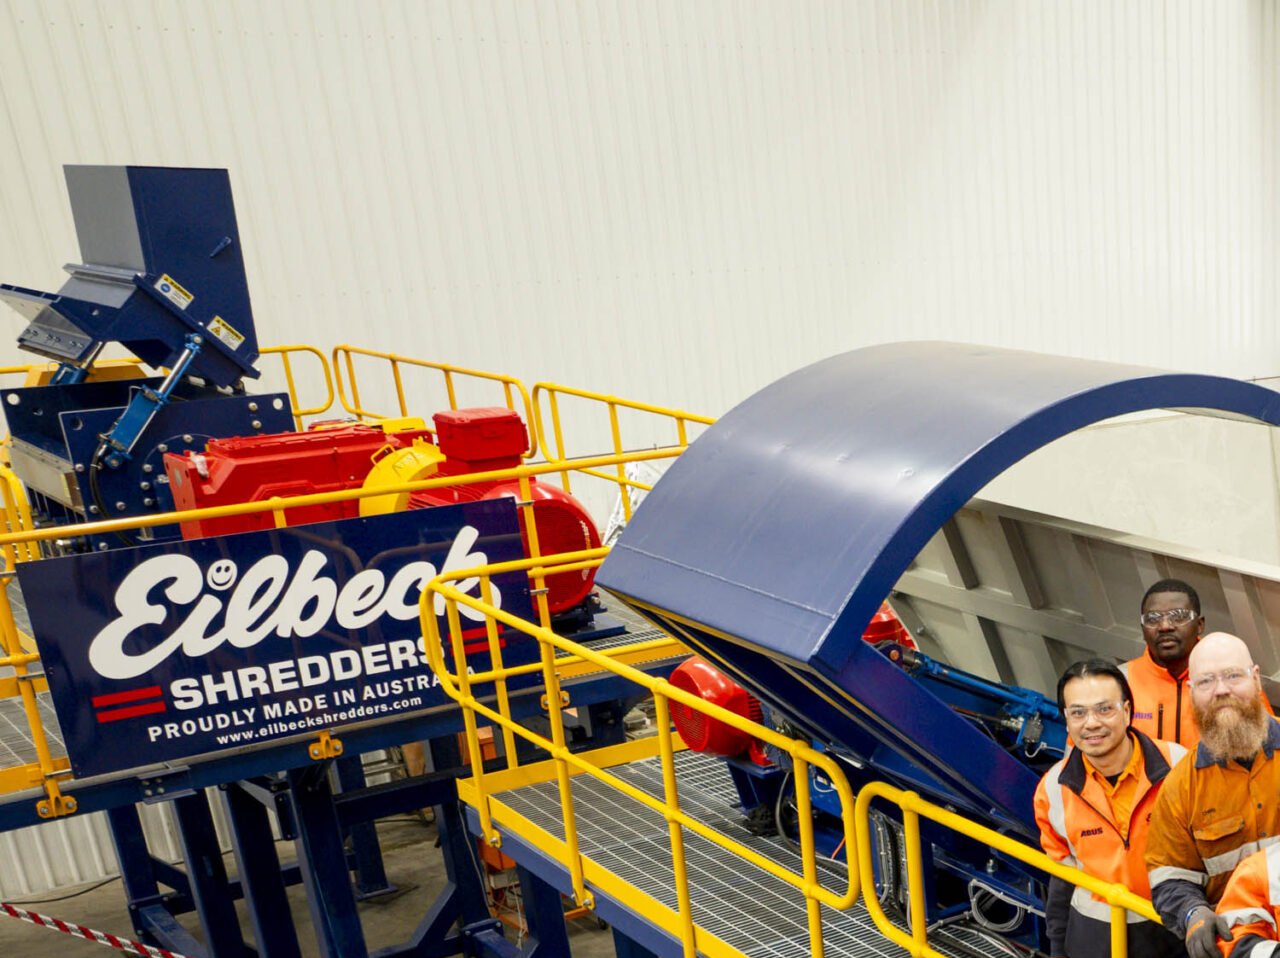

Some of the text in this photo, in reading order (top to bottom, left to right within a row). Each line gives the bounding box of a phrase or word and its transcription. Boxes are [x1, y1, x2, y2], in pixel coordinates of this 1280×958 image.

[89, 525, 502, 680] Eilbeck
[170, 636, 446, 711] SHREDDERS
[148, 707, 256, 742] PROUDLY
[263, 694, 329, 720] MADE
[333, 688, 357, 707] IN
[216, 696, 422, 745] www.eilbeckshredders.com
[1080, 827, 1103, 838] ABUS
